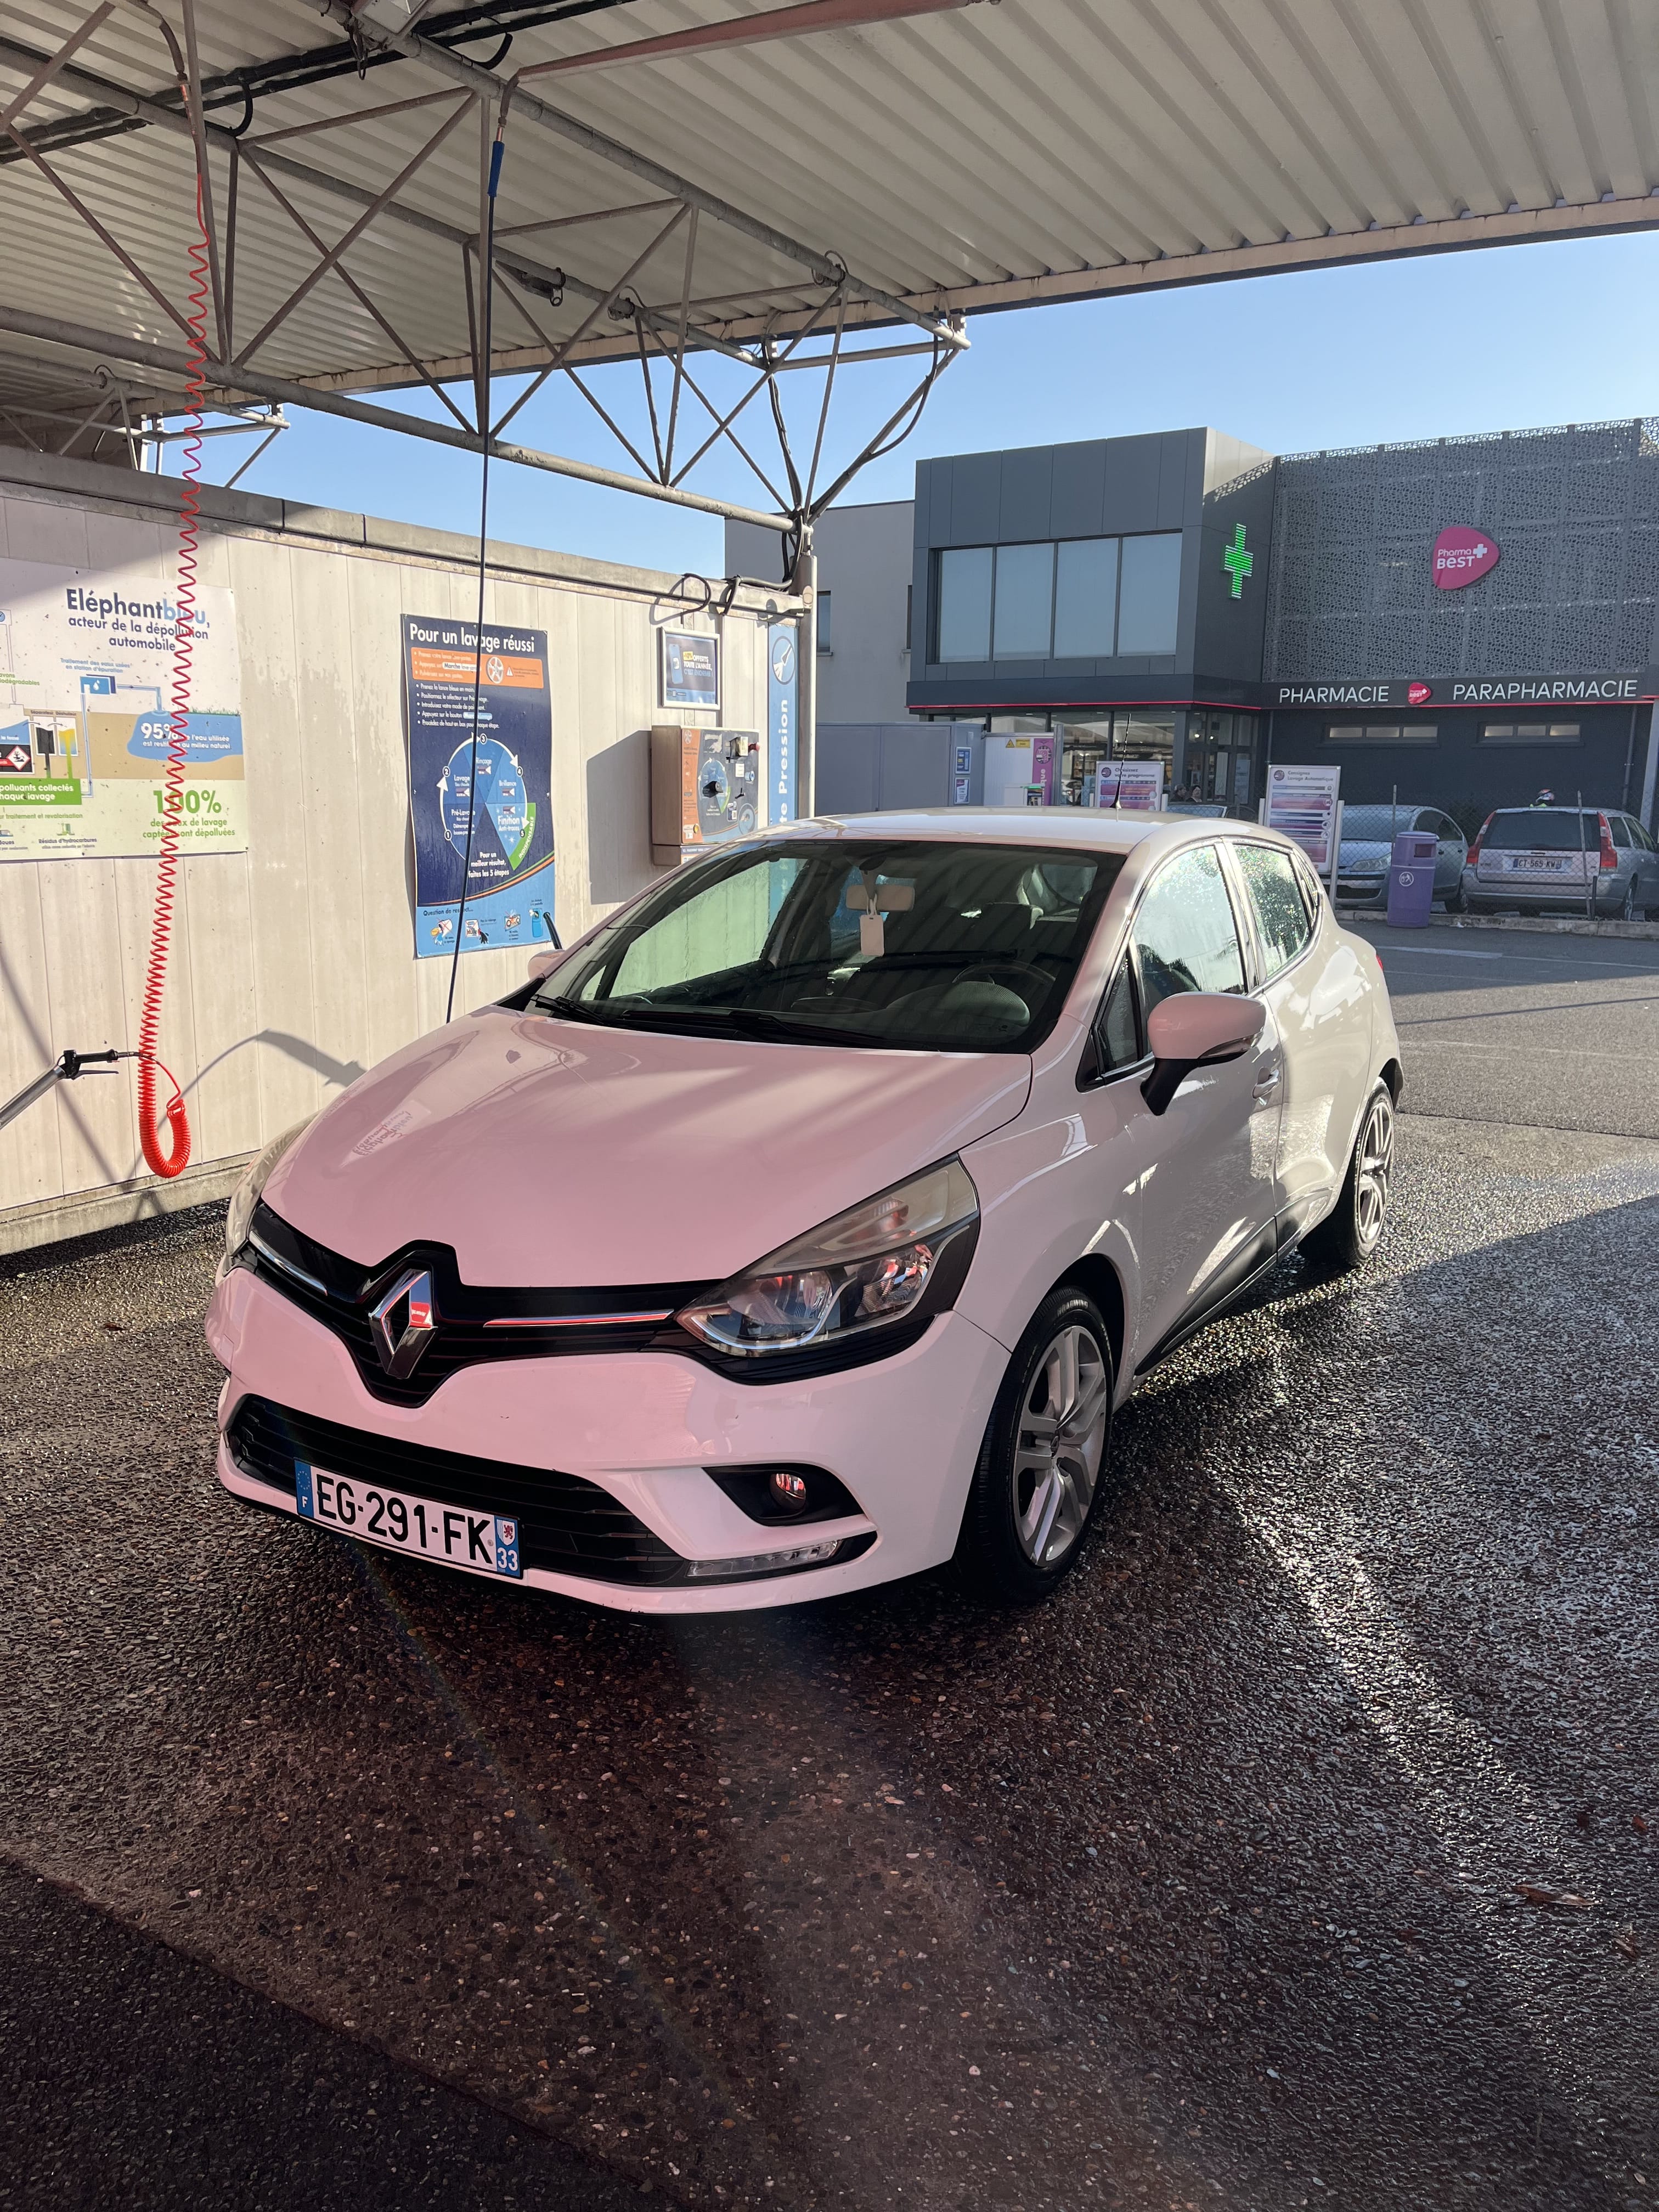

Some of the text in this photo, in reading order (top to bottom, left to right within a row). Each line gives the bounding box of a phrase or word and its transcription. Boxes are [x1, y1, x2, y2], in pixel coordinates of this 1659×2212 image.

[1438, 549, 1471, 557] Pharma
[69, 617, 108, 629] acteur
[112, 618, 127, 631] de
[131, 619, 142, 633] la
[109, 636, 176, 651] automobile
[410, 623, 534, 653] Pour un lavage réussi
[1279, 680, 1638, 703] PHARMACIE PARAPHARMACIE
[140, 723, 178, 740] 95%
[778, 699, 788, 794] Pression
[454, 775, 470, 783] Lavage
[38, 783, 74, 792] collectés
[153, 790, 222, 814] 100%
[190, 818, 200, 826] de
[201, 817, 227, 828] lavage
[498, 815, 520, 825] Finition
[195, 828, 235, 838] dépolluées
[518, 816, 534, 859] INDISPENSABLE
[494, 869, 510, 877] étapes
[423, 907, 444, 916] Question
[302, 1496, 308, 1508] F
[316, 1474, 493, 1564] EG-291-FK
[497, 1548, 518, 1571] 33
